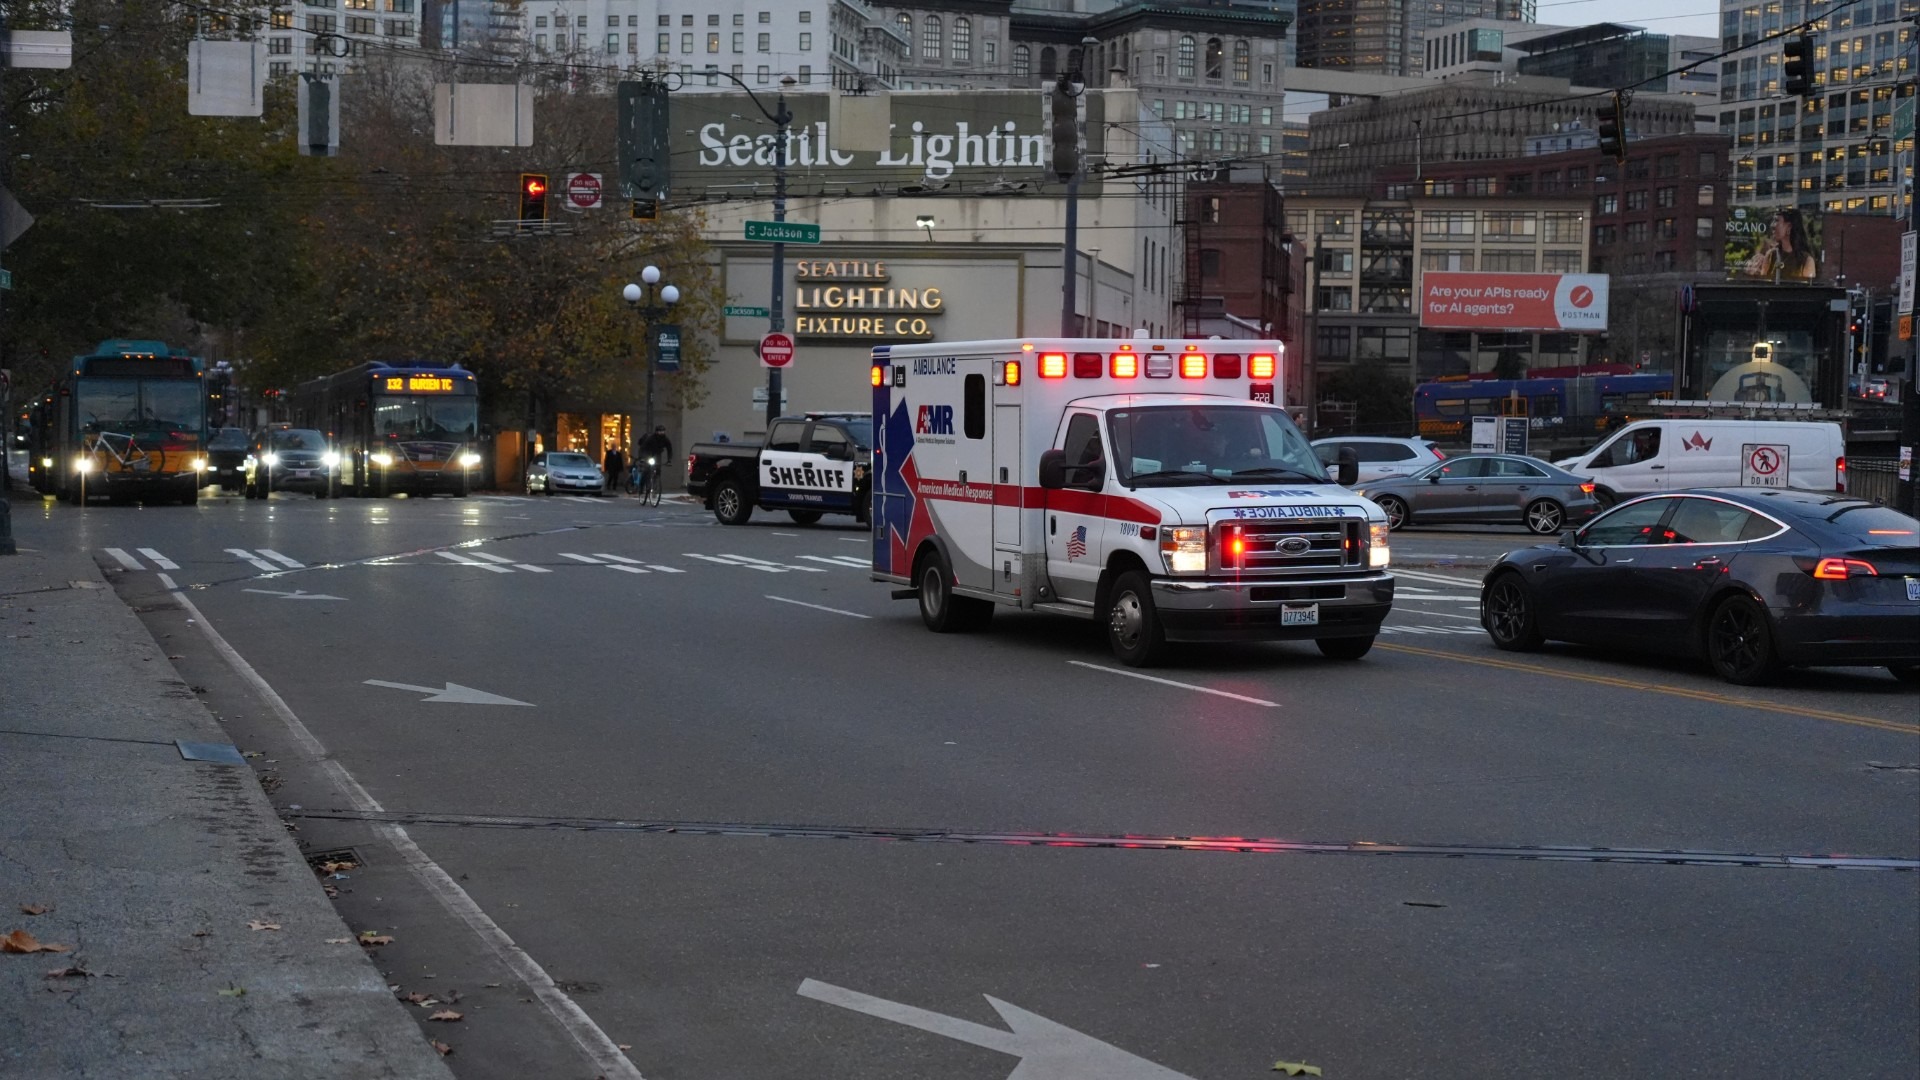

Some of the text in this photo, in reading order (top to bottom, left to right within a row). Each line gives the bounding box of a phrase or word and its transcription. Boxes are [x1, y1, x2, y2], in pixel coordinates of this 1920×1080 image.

[874, 120, 1045, 181] Lightin
[748, 225, 816, 240] S Jackson St
[796, 260, 887, 278] SEATTLE
[795, 286, 943, 309] LIGHTING
[1429, 286, 1550, 301] Are your APIs ready
[729, 307, 755, 316] Jackson
[1429, 301, 1515, 316] for AI agents?
[1562, 311, 1600, 319] POSTMAN
[795, 317, 932, 336] FIXTURE CO.
[913, 358, 956, 376] AMBULANCE
[387, 378, 453, 391] 132 BURIEN TC
[915, 404, 954, 435] AMR
[769, 466, 845, 489] SHERIFF
[1750, 476, 1780, 486] DO NOT
[917, 481, 993, 501] American Medical Response
[1119, 522, 1140, 537] 18093
